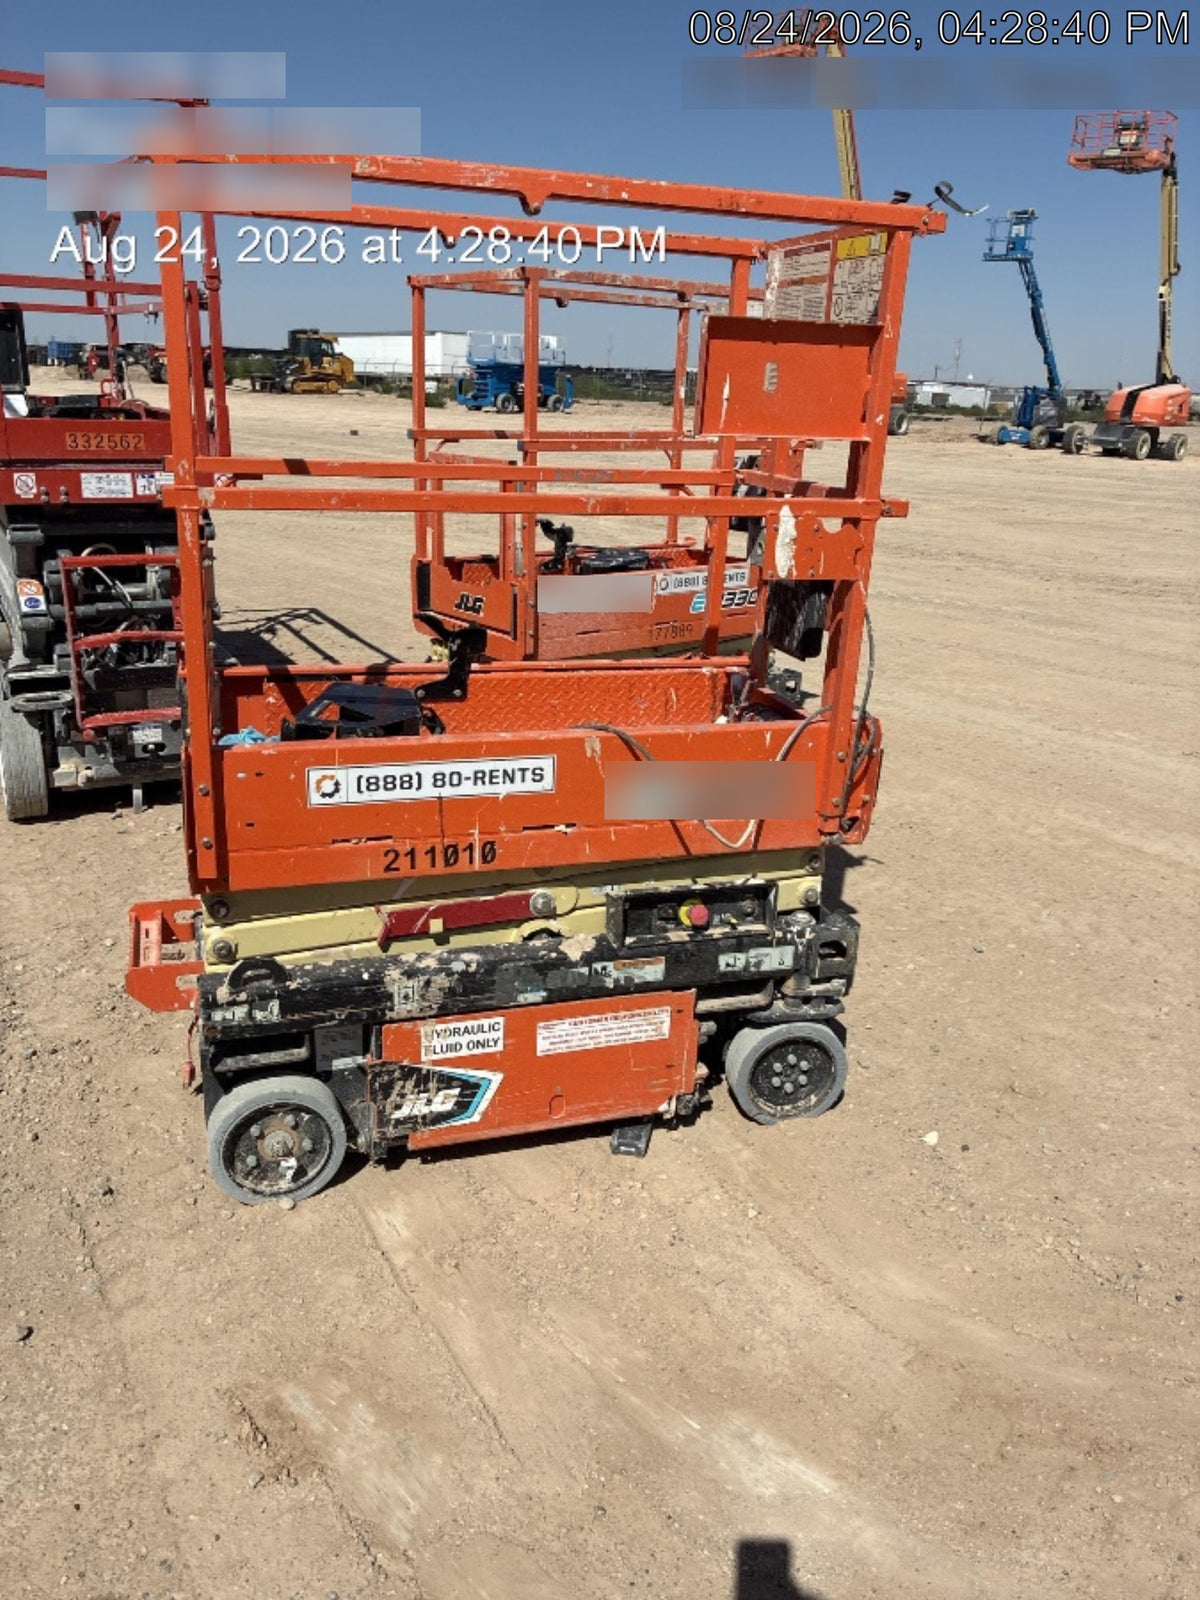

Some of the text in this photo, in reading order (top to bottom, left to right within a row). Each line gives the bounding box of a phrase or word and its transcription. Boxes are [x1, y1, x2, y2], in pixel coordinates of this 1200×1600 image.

[68, 433, 143, 449] 332562
[454, 592, 485, 616] JLG
[356, 767, 545, 794] (888) 80-RENTS
[384, 841, 497, 874] 211010
[466, 1036, 500, 1052] ONLY
